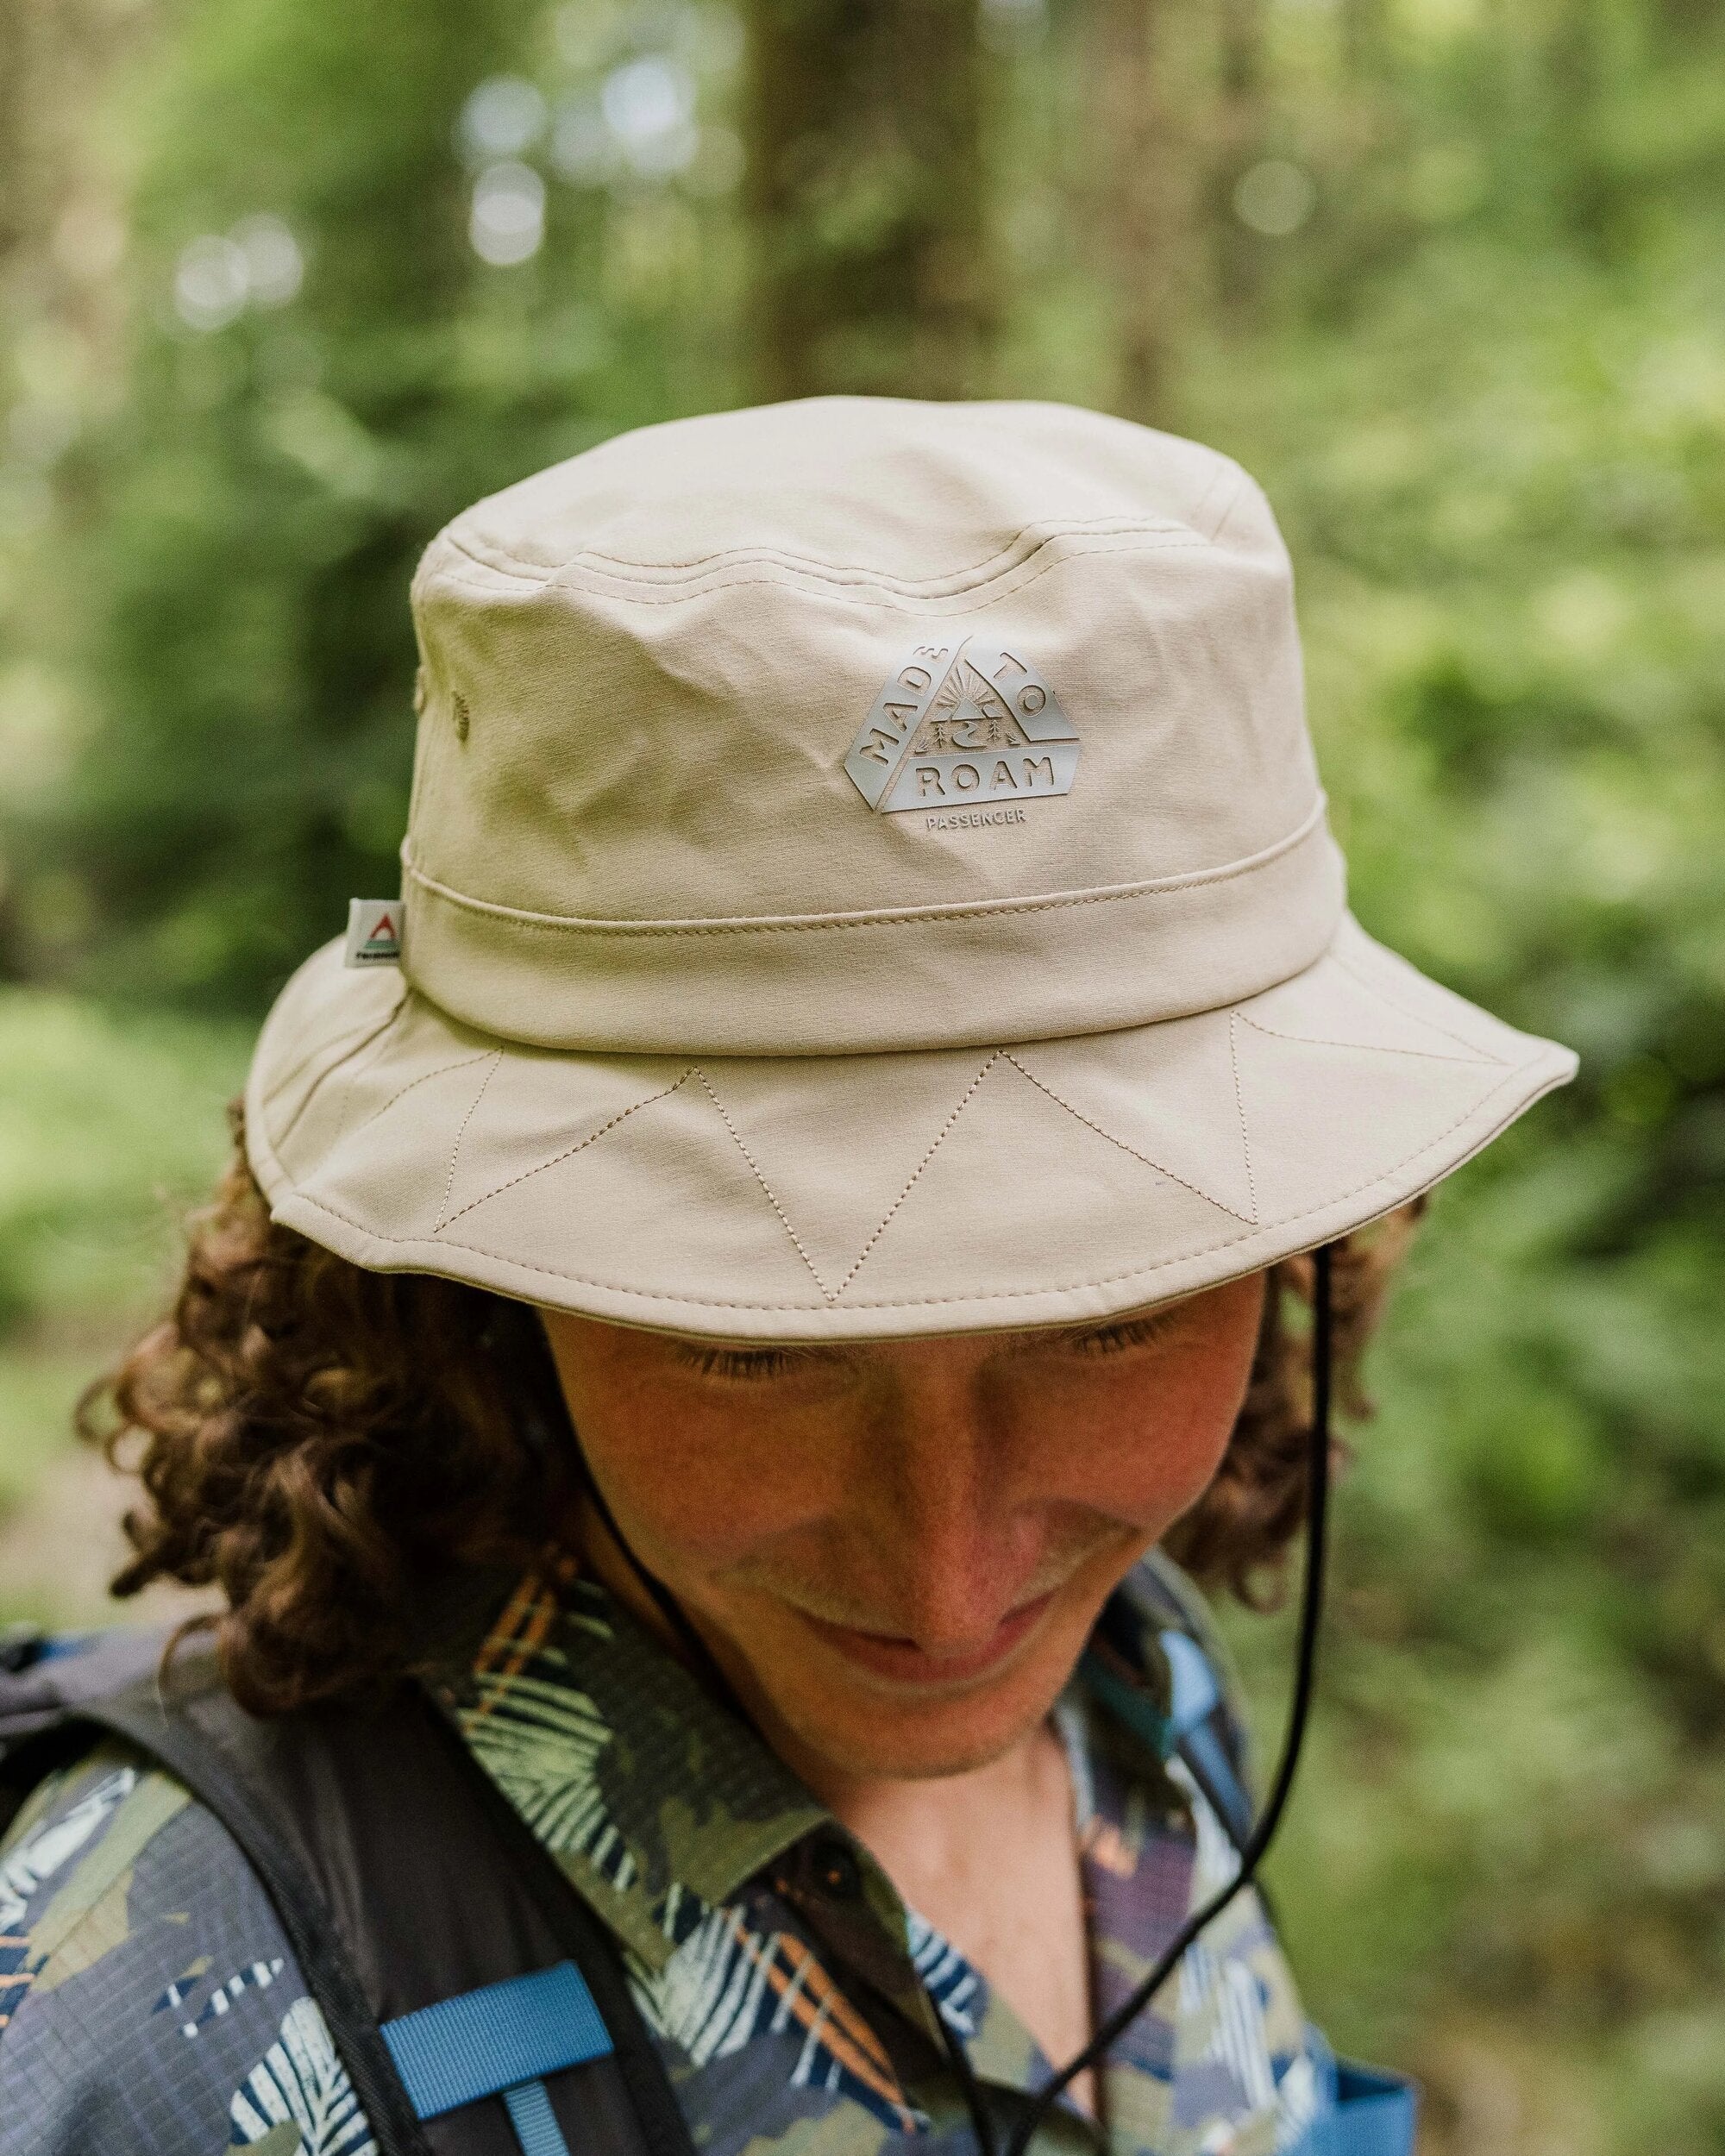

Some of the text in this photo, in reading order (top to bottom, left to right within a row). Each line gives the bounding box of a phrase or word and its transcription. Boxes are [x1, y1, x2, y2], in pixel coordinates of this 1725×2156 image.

[859, 646, 1046, 767] MADE TO
[915, 756, 1055, 797] ROAM
